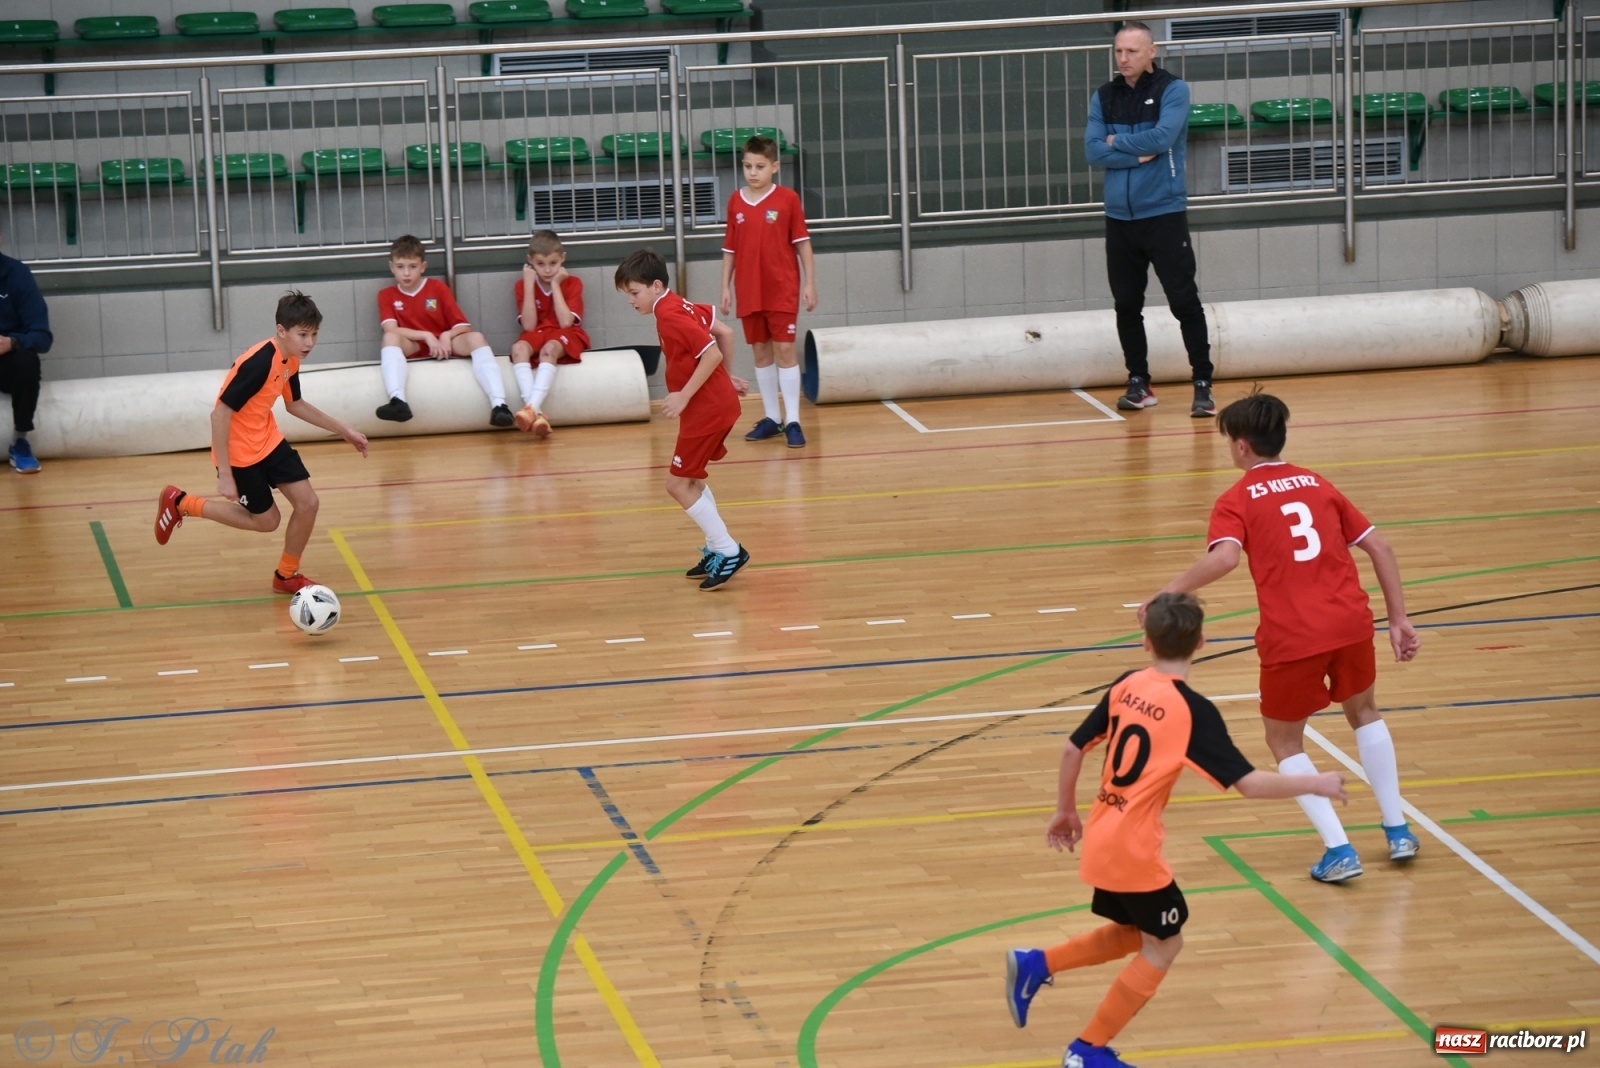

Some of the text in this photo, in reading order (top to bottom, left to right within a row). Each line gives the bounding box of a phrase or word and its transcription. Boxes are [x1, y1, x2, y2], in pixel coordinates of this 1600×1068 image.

[1246, 475, 1320, 499] ZS KIETRZ
[1280, 502, 1322, 562] 3
[1161, 907, 1180, 926] 10
